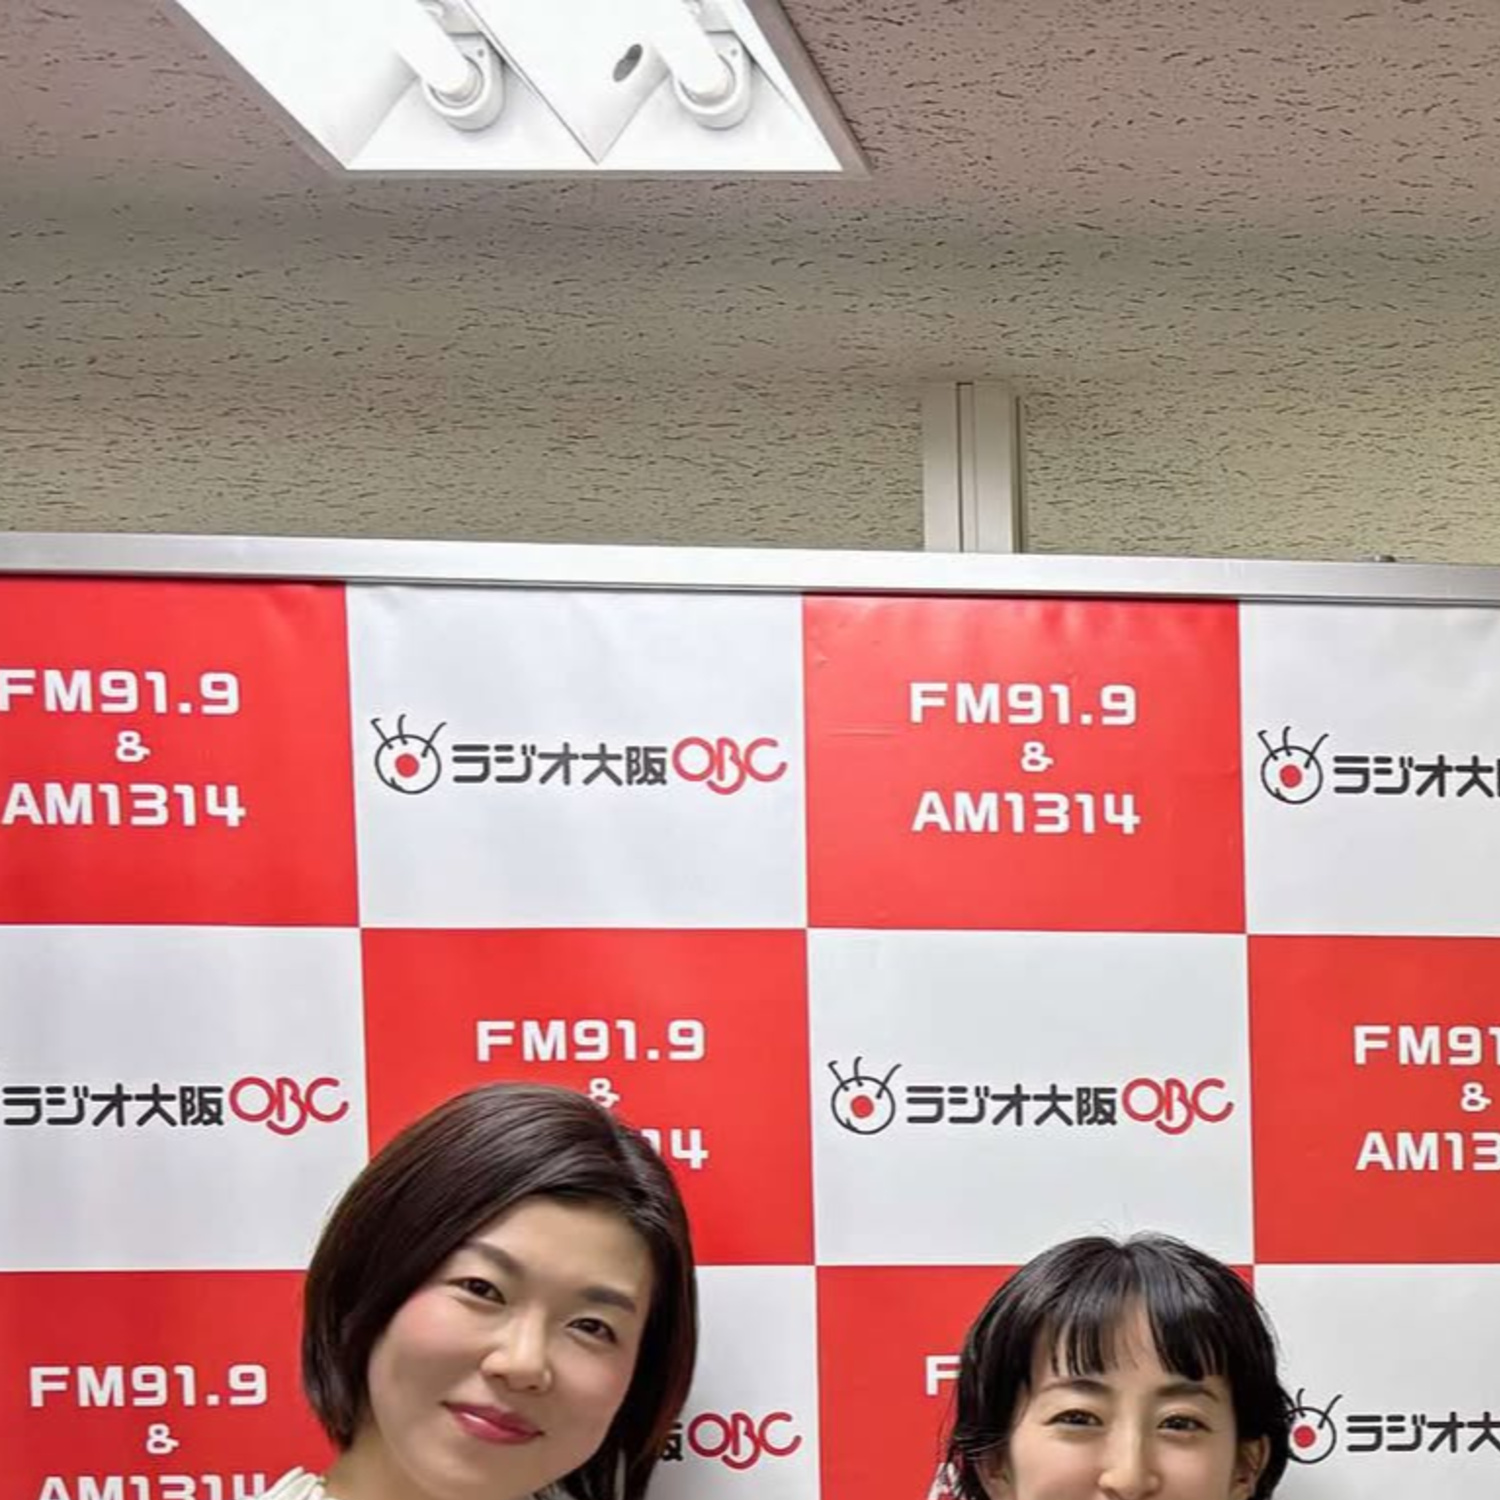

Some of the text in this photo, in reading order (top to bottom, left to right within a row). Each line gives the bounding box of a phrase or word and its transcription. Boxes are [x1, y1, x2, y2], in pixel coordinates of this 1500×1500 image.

[0, 669, 240, 715] FM91.9
[909, 682, 1138, 726] FM91.9
[116, 730, 151, 762] &
[1021, 741, 1053, 772] &
[1, 783, 246, 827] AM1314
[912, 791, 1141, 834] AM1314
[476, 1019, 705, 1062] FM91.9
[1461, 1084, 1491, 1112] &
[29, 1364, 268, 1408] FM91.9
[146, 1423, 180, 1455] &
